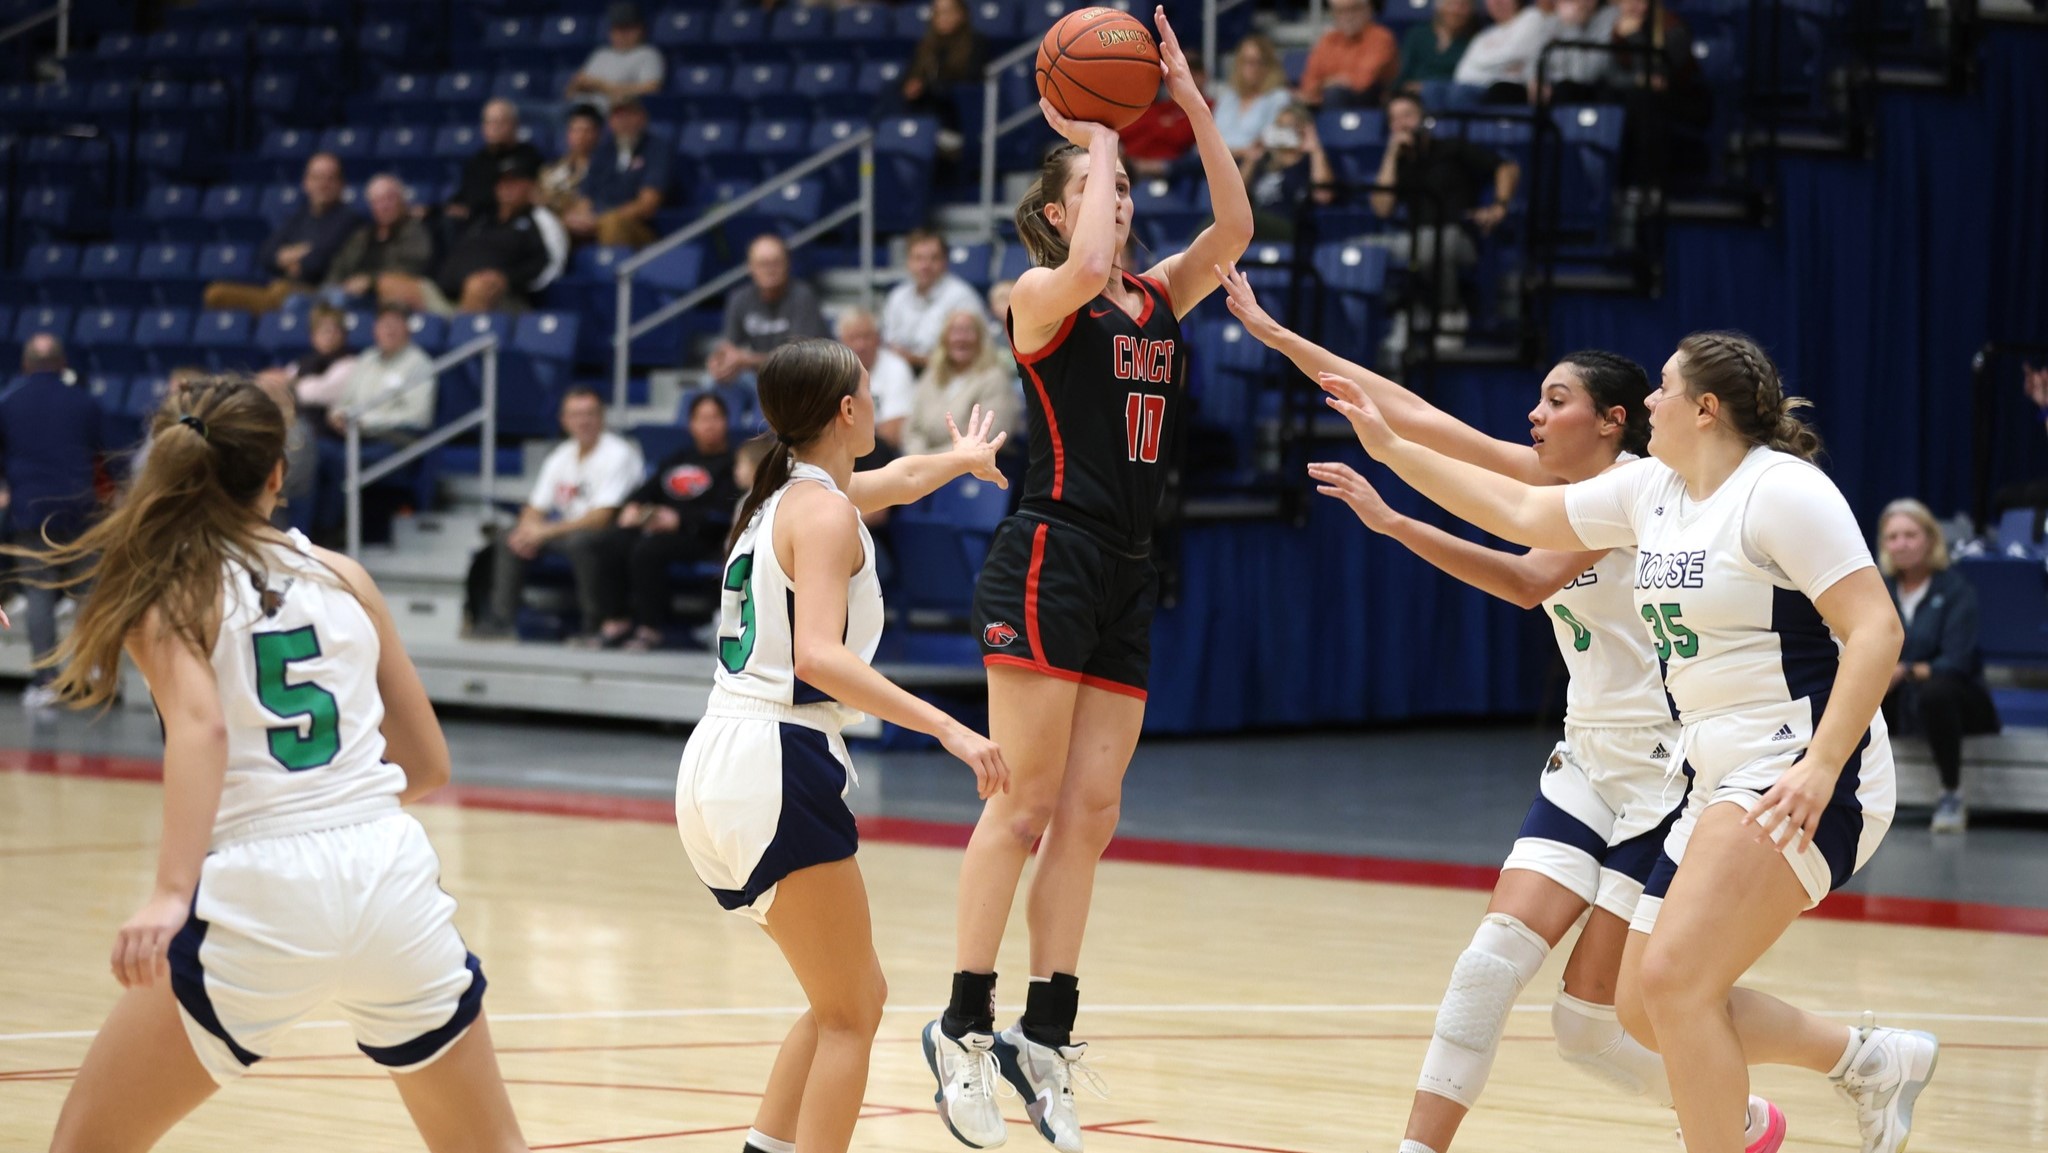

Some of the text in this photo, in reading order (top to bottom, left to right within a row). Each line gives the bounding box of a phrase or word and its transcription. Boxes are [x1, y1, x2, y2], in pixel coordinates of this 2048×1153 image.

[1096, 27, 1156, 48] ALDING
[1125, 392, 1166, 463] 10
[719, 551, 757, 675] 3
[1553, 604, 1592, 652] 0
[1641, 603, 1699, 662] 35
[252, 624, 342, 773] 5
[1771, 733, 1797, 742] adidas
